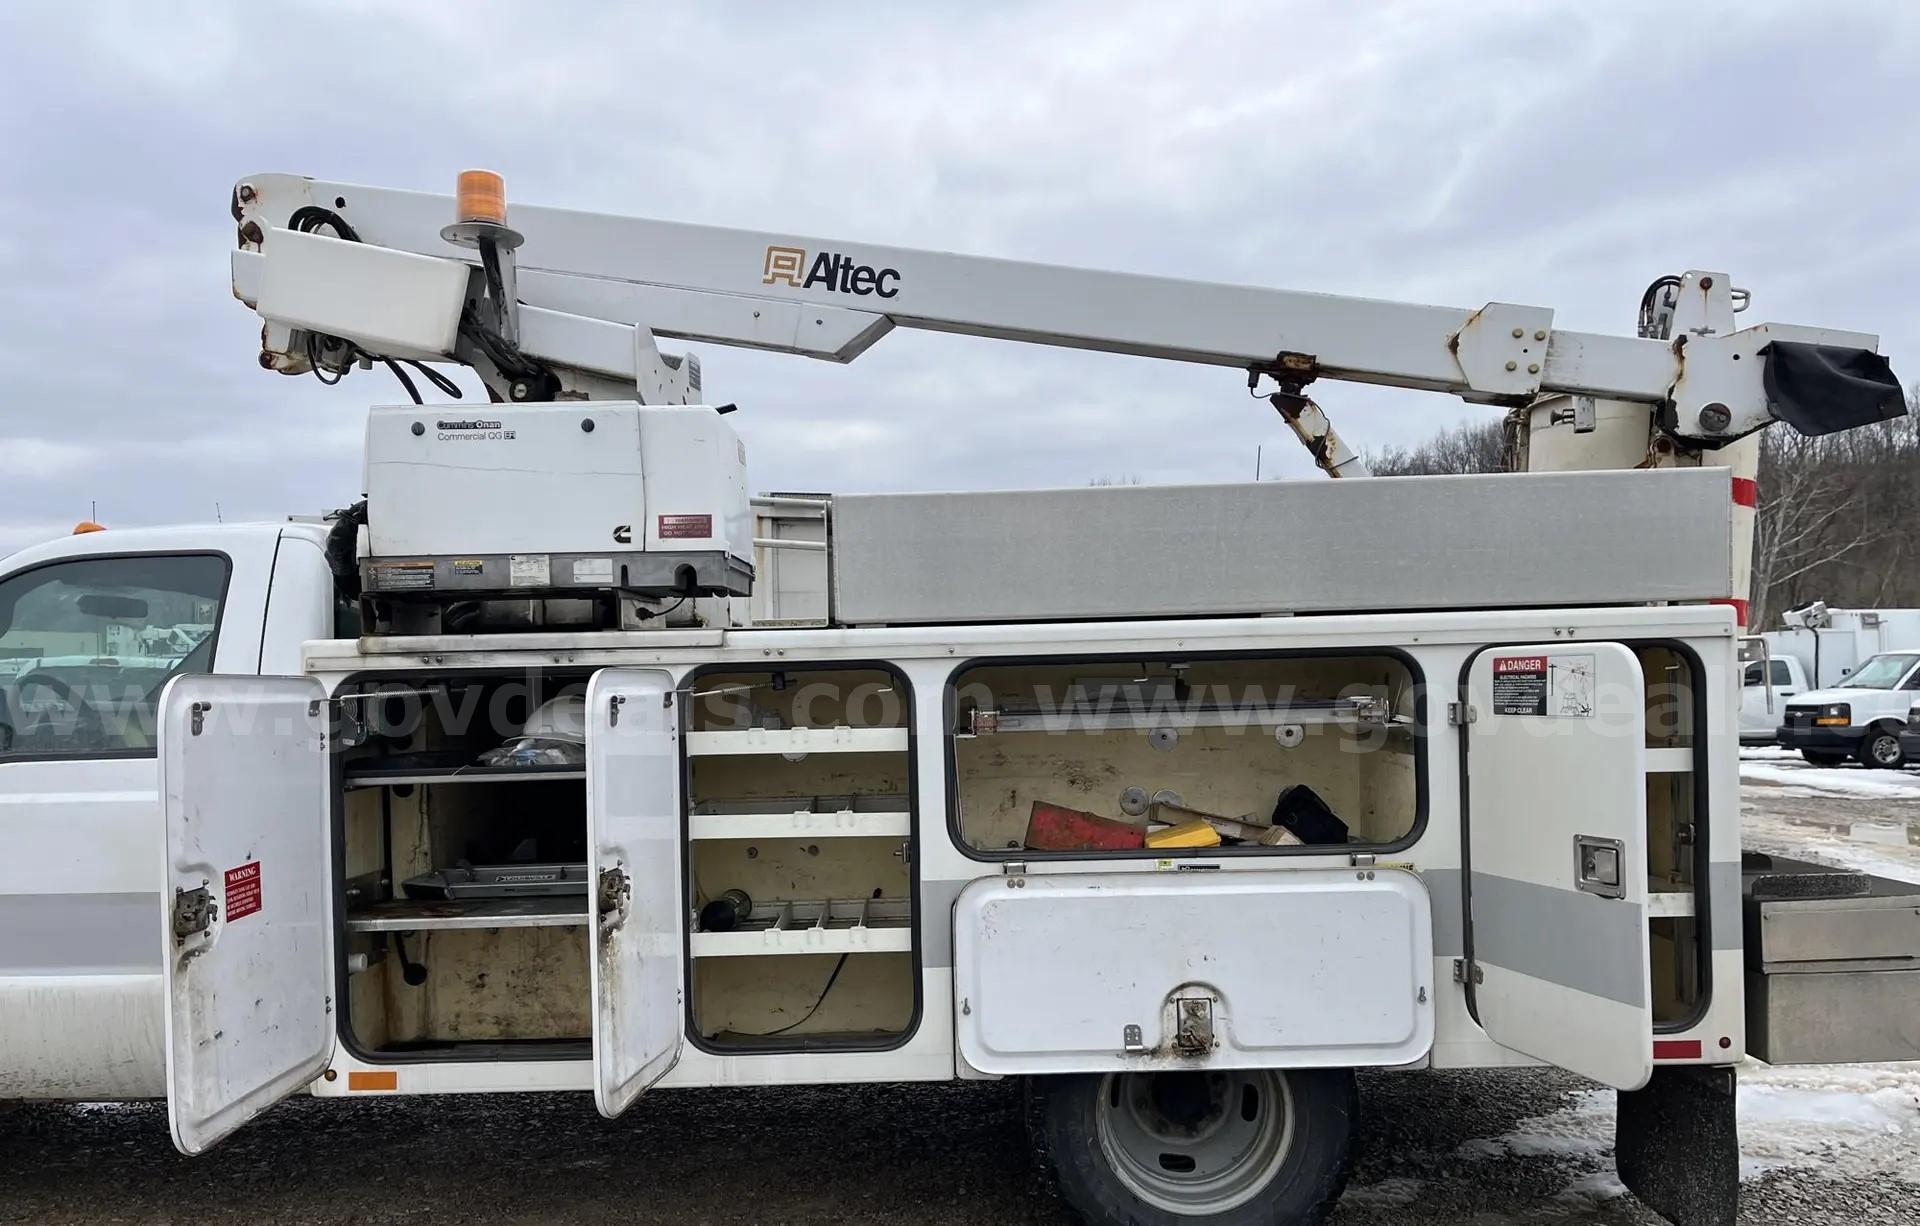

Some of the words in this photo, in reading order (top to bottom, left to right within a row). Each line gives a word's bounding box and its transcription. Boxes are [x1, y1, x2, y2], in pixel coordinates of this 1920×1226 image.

[802, 252, 901, 298] Altec
[475, 420, 502, 429] Onan
[437, 432, 486, 440] Commercial
[1507, 659, 1541, 671] DANGER
[229, 867, 256, 881] WARNING
